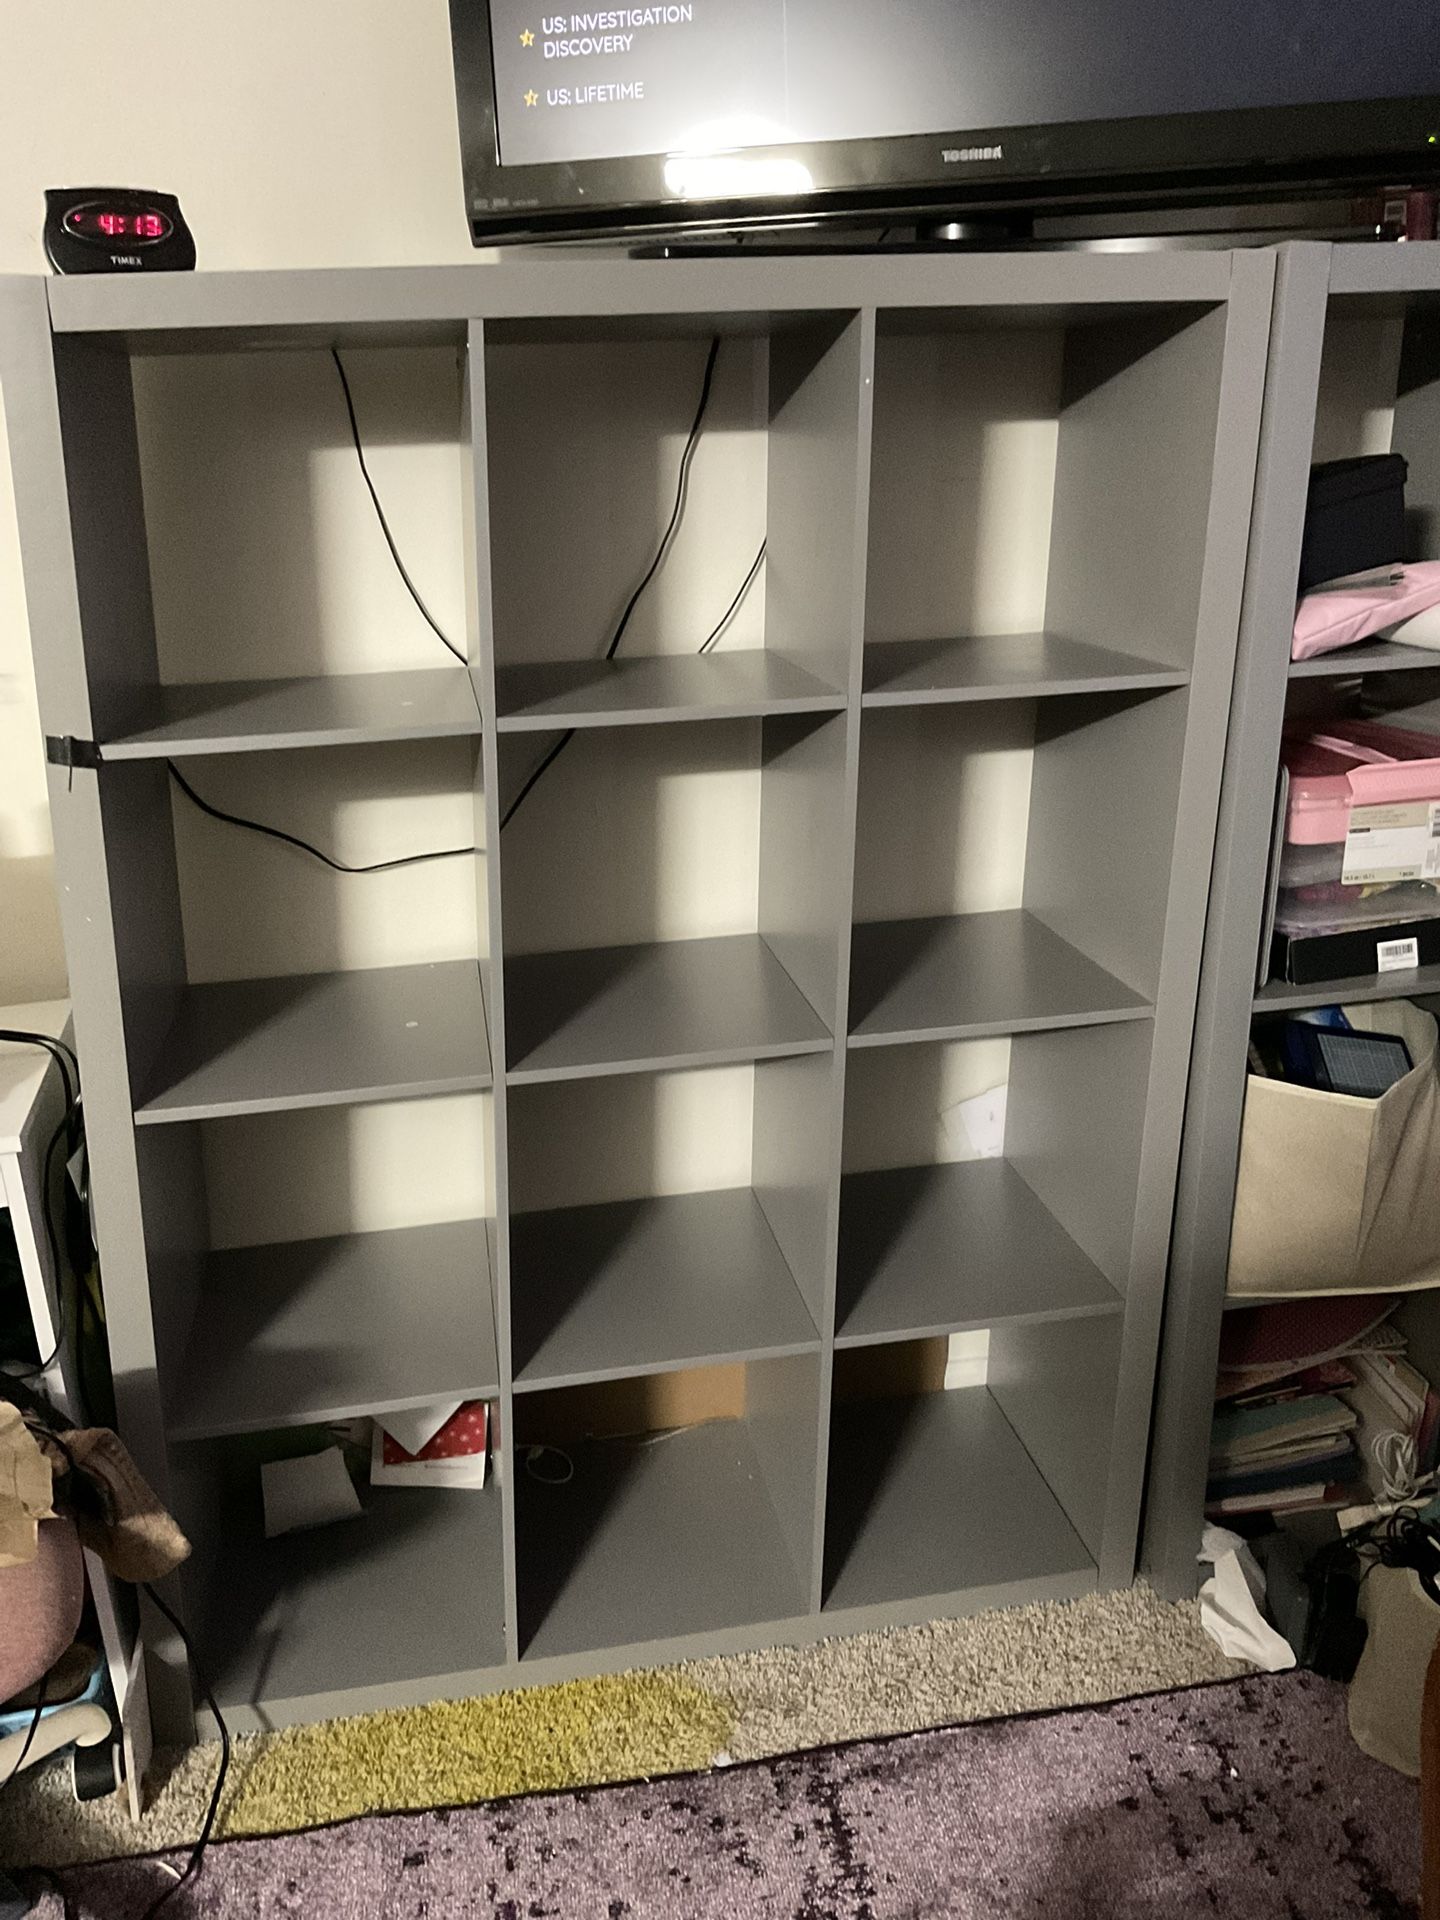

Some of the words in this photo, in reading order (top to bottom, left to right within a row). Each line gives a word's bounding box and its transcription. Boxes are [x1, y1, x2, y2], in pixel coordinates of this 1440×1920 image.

[542, 17, 567, 34] US:
[571, 4, 692, 32] INVESTIGATION
[544, 34, 633, 58] DISCOVERY
[547, 90, 571, 106] US:
[575, 83, 644, 104] LIFETIME
[941, 145, 1001, 162] TOSHIBA
[99, 215, 162, 236] 4:13
[110, 256, 142, 265] TIMEX
